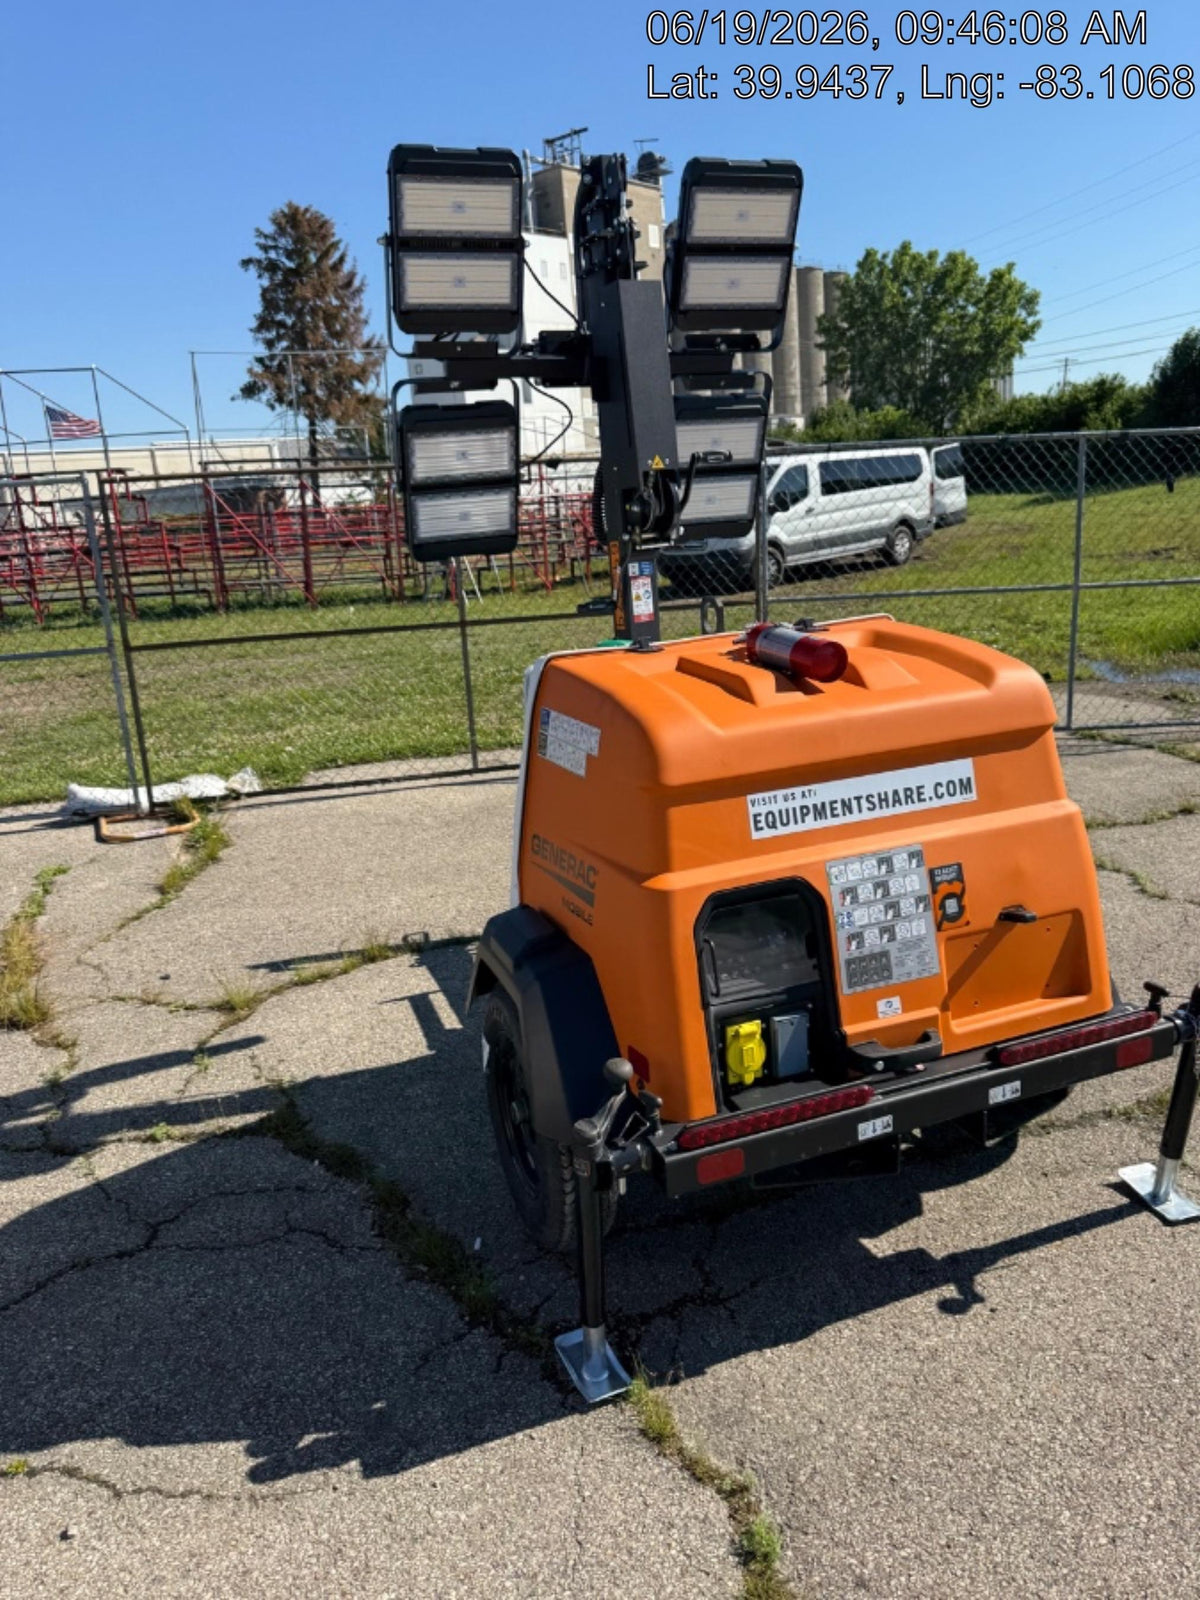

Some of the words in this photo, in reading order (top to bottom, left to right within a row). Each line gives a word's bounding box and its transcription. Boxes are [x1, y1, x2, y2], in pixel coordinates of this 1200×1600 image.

[749, 793, 778, 808] VISIT
[782, 791, 796, 802] US
[752, 776, 974, 833] EQUIPMENTSHARE.COM
[531, 834, 598, 890] GENERAC
